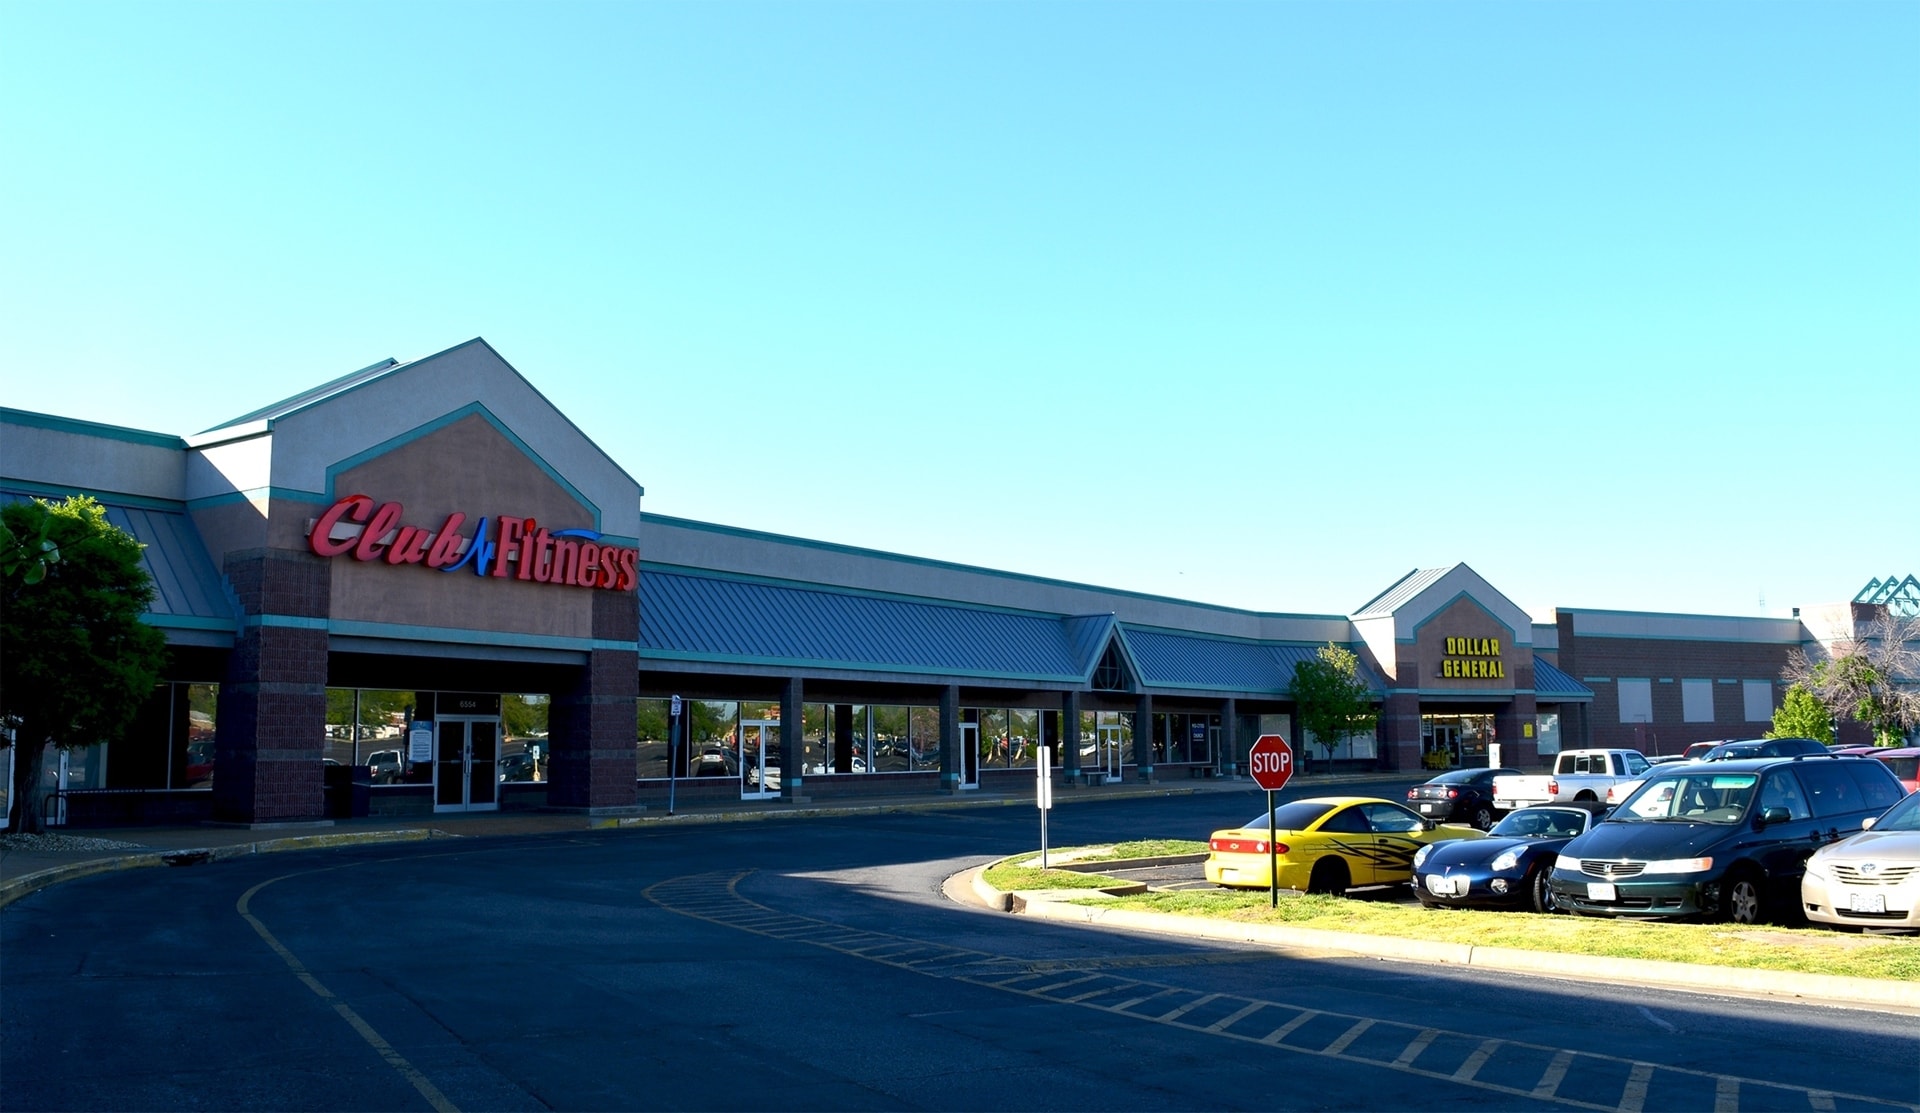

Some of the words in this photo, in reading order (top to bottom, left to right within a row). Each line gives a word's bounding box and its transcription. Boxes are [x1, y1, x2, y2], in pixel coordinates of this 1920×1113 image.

[309, 494, 466, 568] Club
[491, 515, 638, 591] Fitness
[1445, 637, 1500, 656] DOLLAR
[1442, 659, 1504, 678] GENERAL
[1253, 752, 1290, 773] STOP
